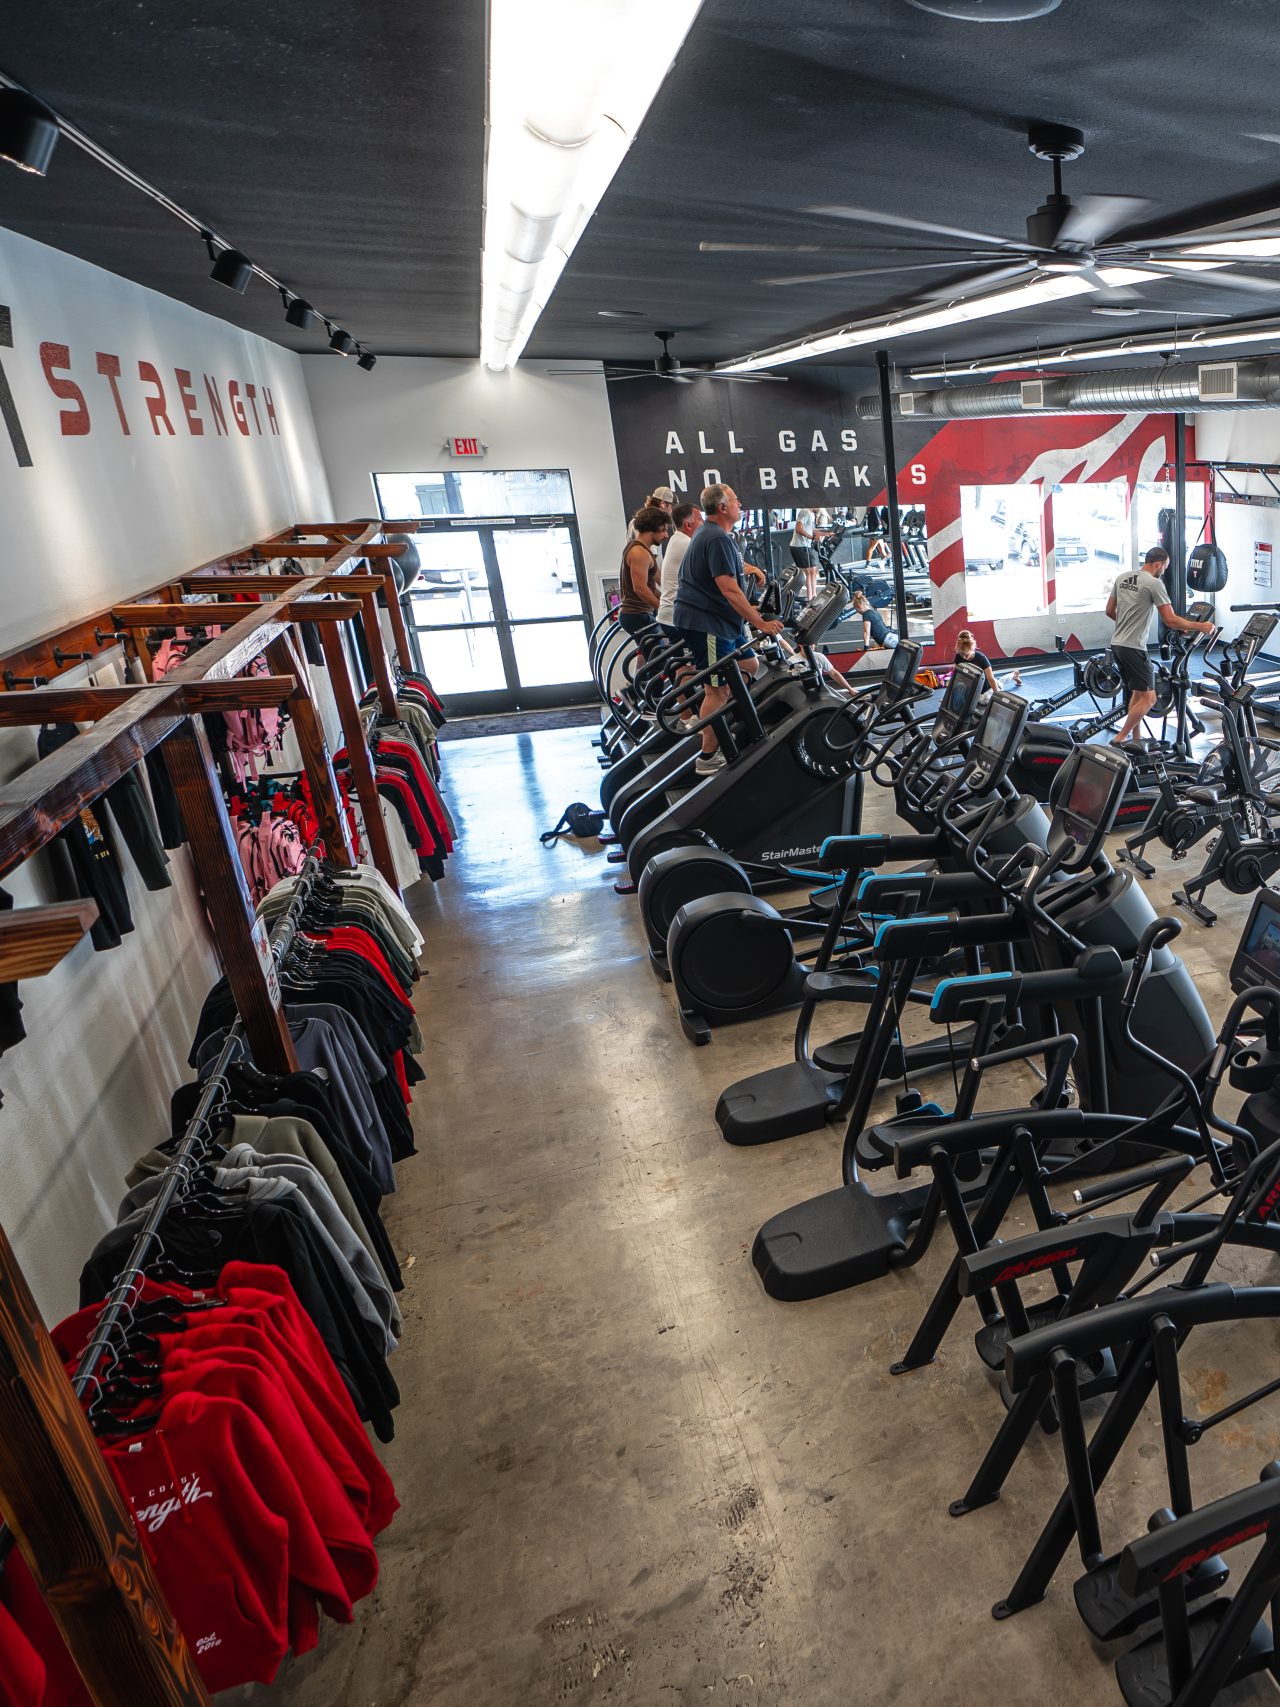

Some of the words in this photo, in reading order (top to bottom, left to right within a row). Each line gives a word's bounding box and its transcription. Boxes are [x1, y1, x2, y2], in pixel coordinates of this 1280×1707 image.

[39, 341, 280, 437] STRENGTH
[454, 438, 478, 455] EXIT
[666, 431, 744, 454] ALL
[778, 429, 858, 452] GAS
[759, 464, 926, 490] BRAKS
[1119, 582, 1139, 592] adidas
[1244, 800, 1256, 835] ROGUE
[761, 844, 821, 861] StairMaste
